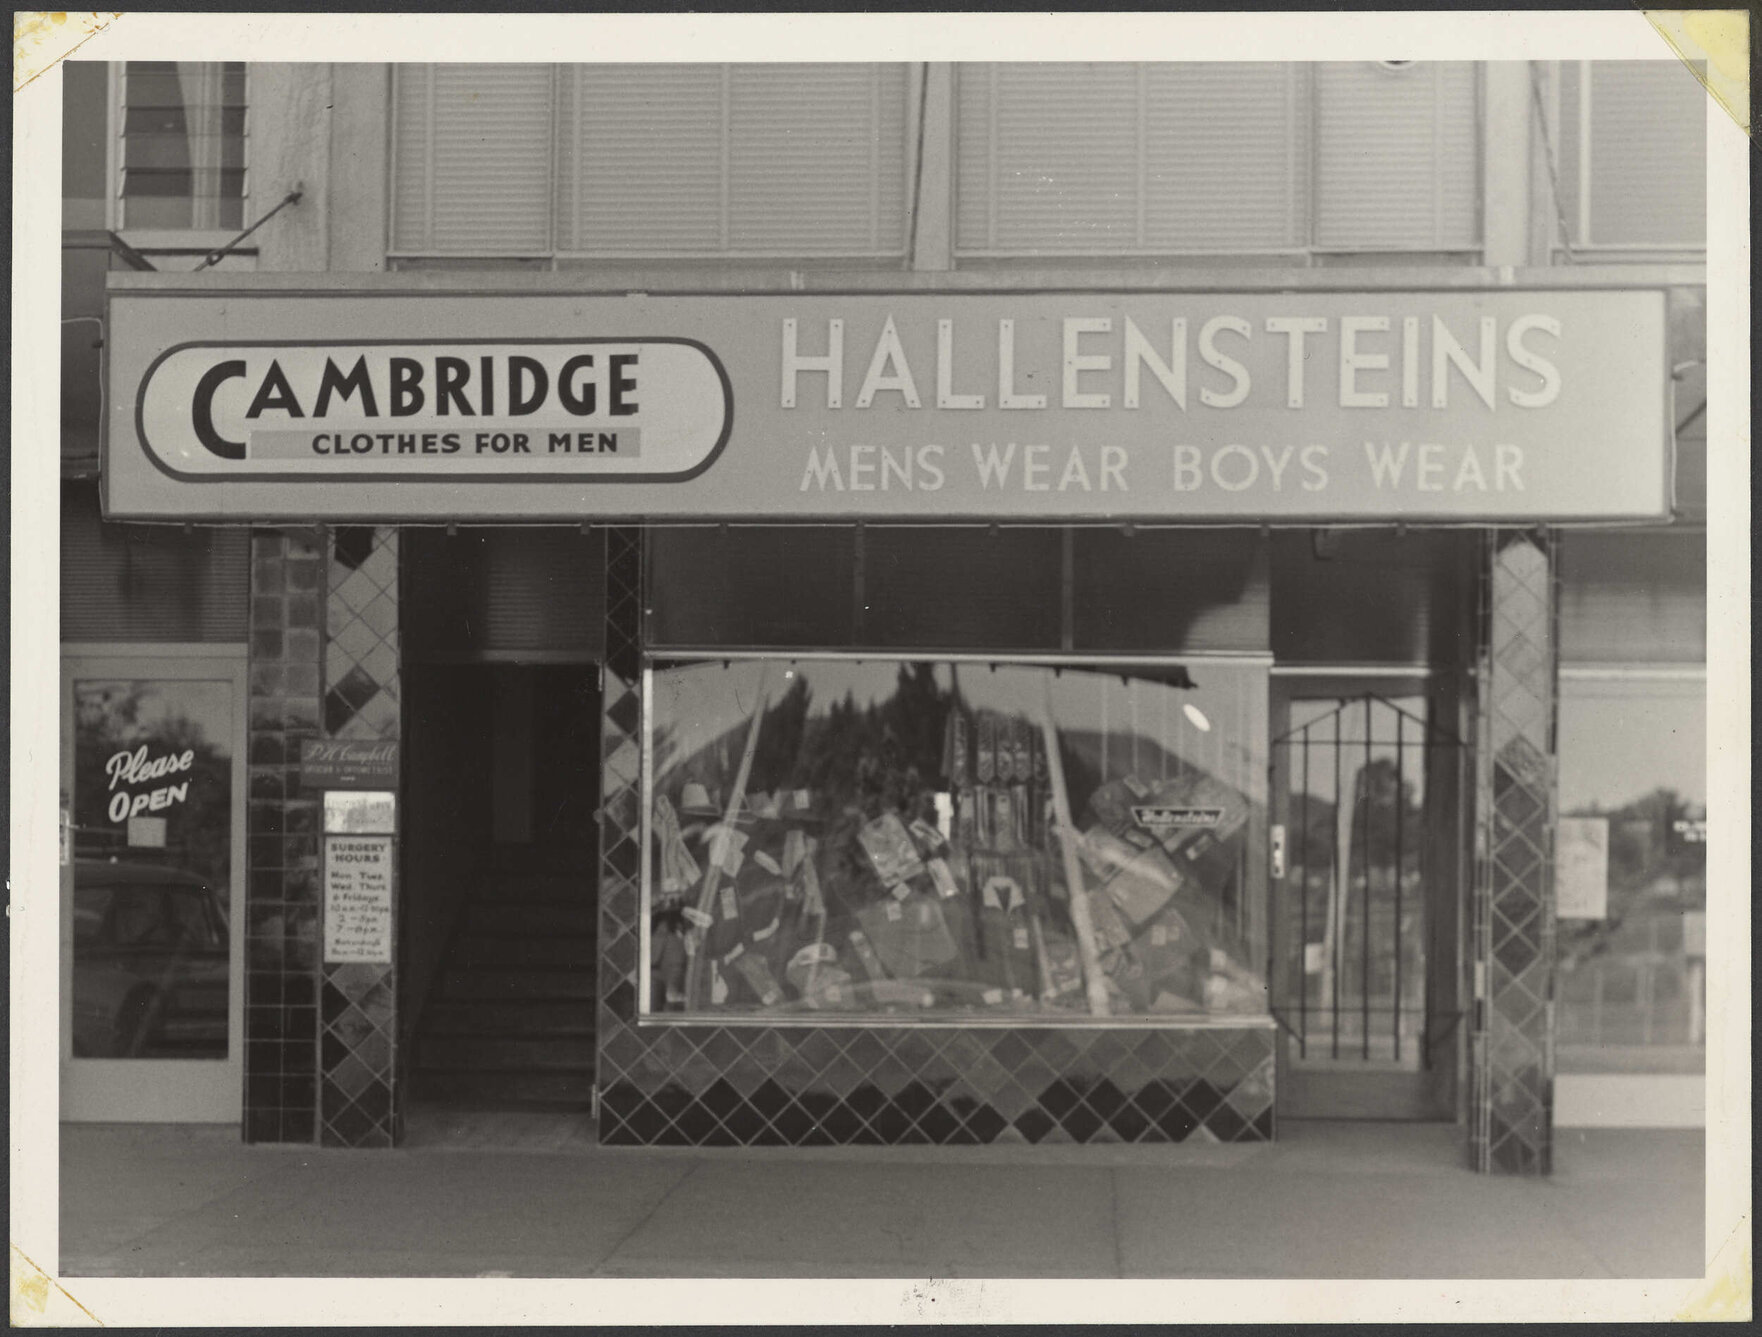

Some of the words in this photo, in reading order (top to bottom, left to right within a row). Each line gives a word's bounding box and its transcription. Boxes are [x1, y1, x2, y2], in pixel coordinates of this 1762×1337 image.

[780, 313, 1563, 412] HALLENSTEINS
[192, 353, 640, 460] CAMBRIDGE
[312, 433, 461, 455] CLOTHES
[475, 433, 531, 454] FOR
[548, 432, 619, 454] MEN
[799, 444, 945, 494] MENS
[971, 443, 1128, 493] WEAR
[1173, 443, 1329, 493] BOYS
[1364, 442, 1526, 492] WEAR
[105, 744, 194, 791] Please
[108, 781, 189, 823] OPEN
[330, 843, 387, 852] SURGERY
[335, 854, 380, 863] HOURS
